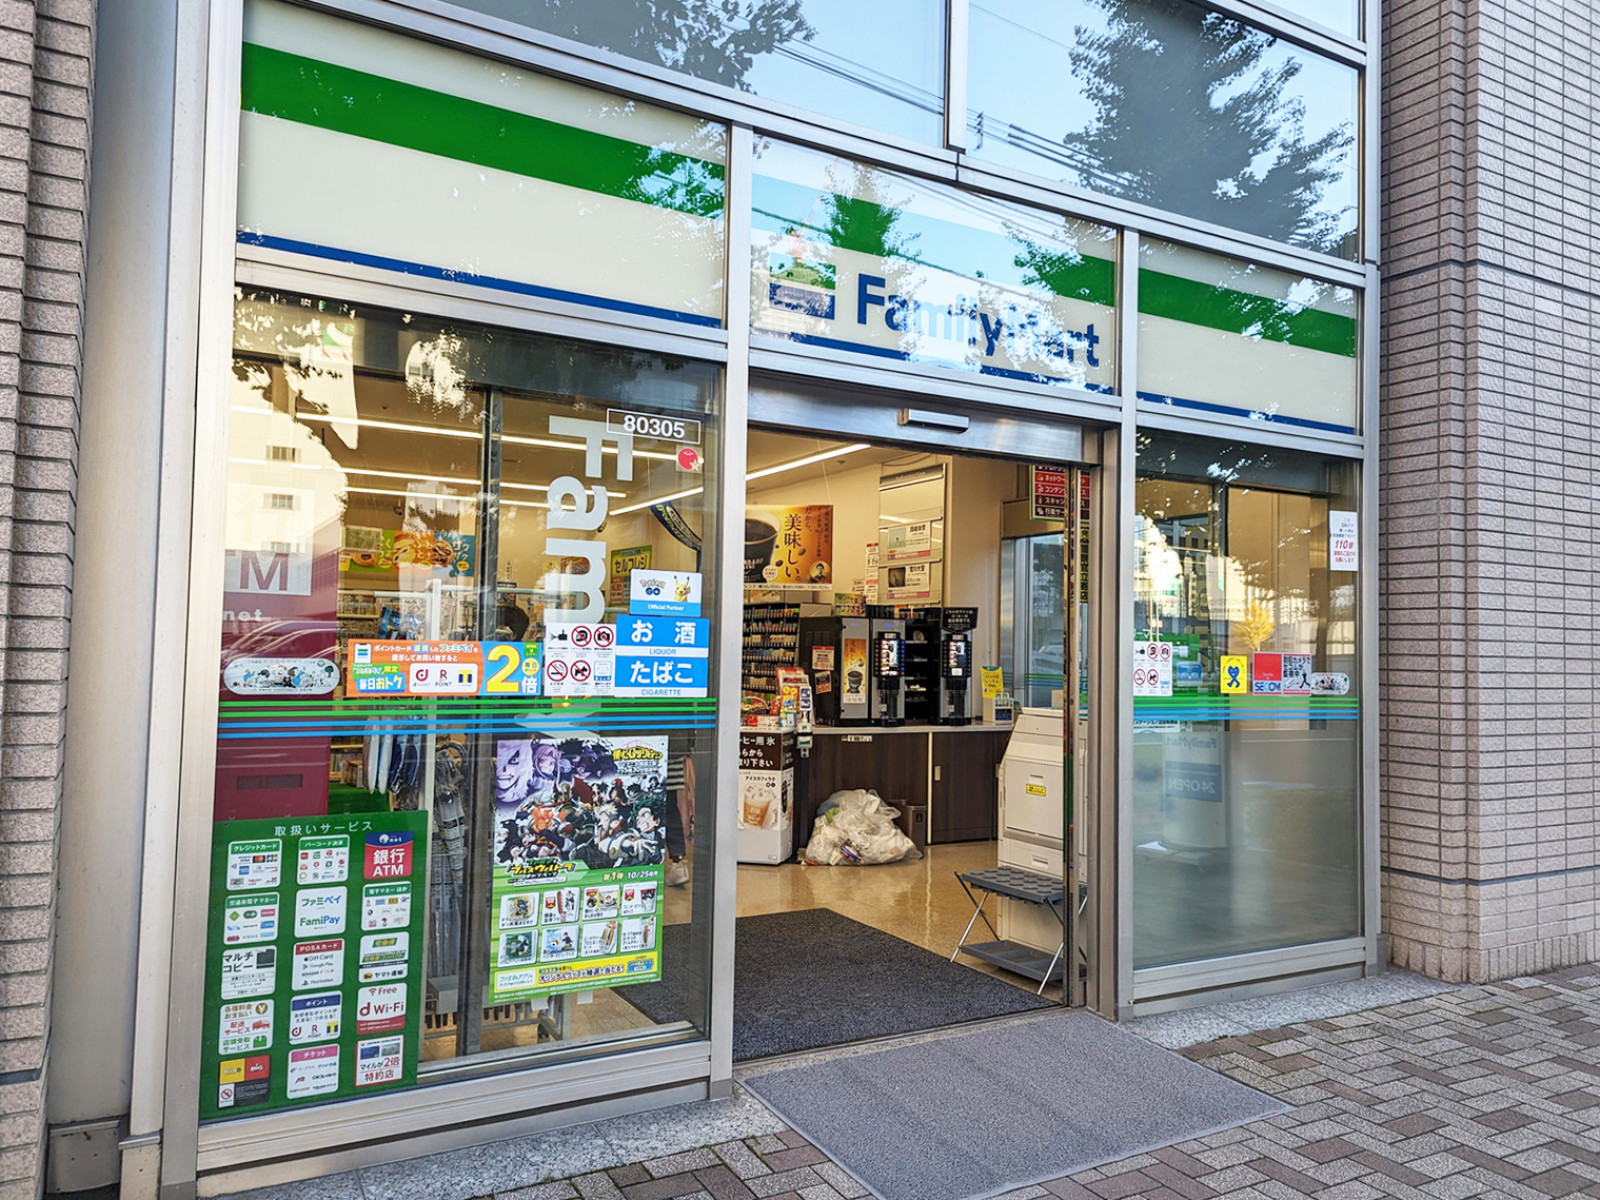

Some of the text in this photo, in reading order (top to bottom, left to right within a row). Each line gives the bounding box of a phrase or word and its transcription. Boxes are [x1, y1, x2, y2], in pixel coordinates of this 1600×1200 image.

[623, 415, 685, 438] 80305
[784, 513, 802, 581] 美味しい。
[645, 587, 661, 596] GO
[630, 619, 696, 645] お酒
[649, 648, 677, 656] LIQUOR
[630, 660, 694, 684] たばこ
[360, 674, 403, 690] 毎日おトク
[1254, 681, 1281, 692] SECOM
[641, 688, 682, 696] CIGARETTE
[766, 736, 776, 746] 氷
[274, 821, 373, 837] 取扱いサービス
[233, 843, 278, 852] クレジットカード
[373, 848, 405, 865] 銀行
[372, 864, 404, 877] ATM
[301, 895, 342, 908] ファミペイ
[300, 915, 341, 927] FamiPay
[299, 943, 338, 952] POSAカード
[223, 951, 254, 963] マルチ
[223, 963, 254, 973] コピー
[378, 987, 398, 995] Free
[224, 1003, 253, 1013] 各種料金
[306, 999, 328, 1007] ポイント
[374, 1001, 404, 1015] Wi-Fi
[224, 1011, 253, 1020] お支払い
[230, 1021, 245, 1029] 配送
[224, 1027, 251, 1036] サービス
[223, 1044, 251, 1053] サービス
[303, 1049, 327, 1059] チケット
[364, 1069, 394, 1082] 特約店
